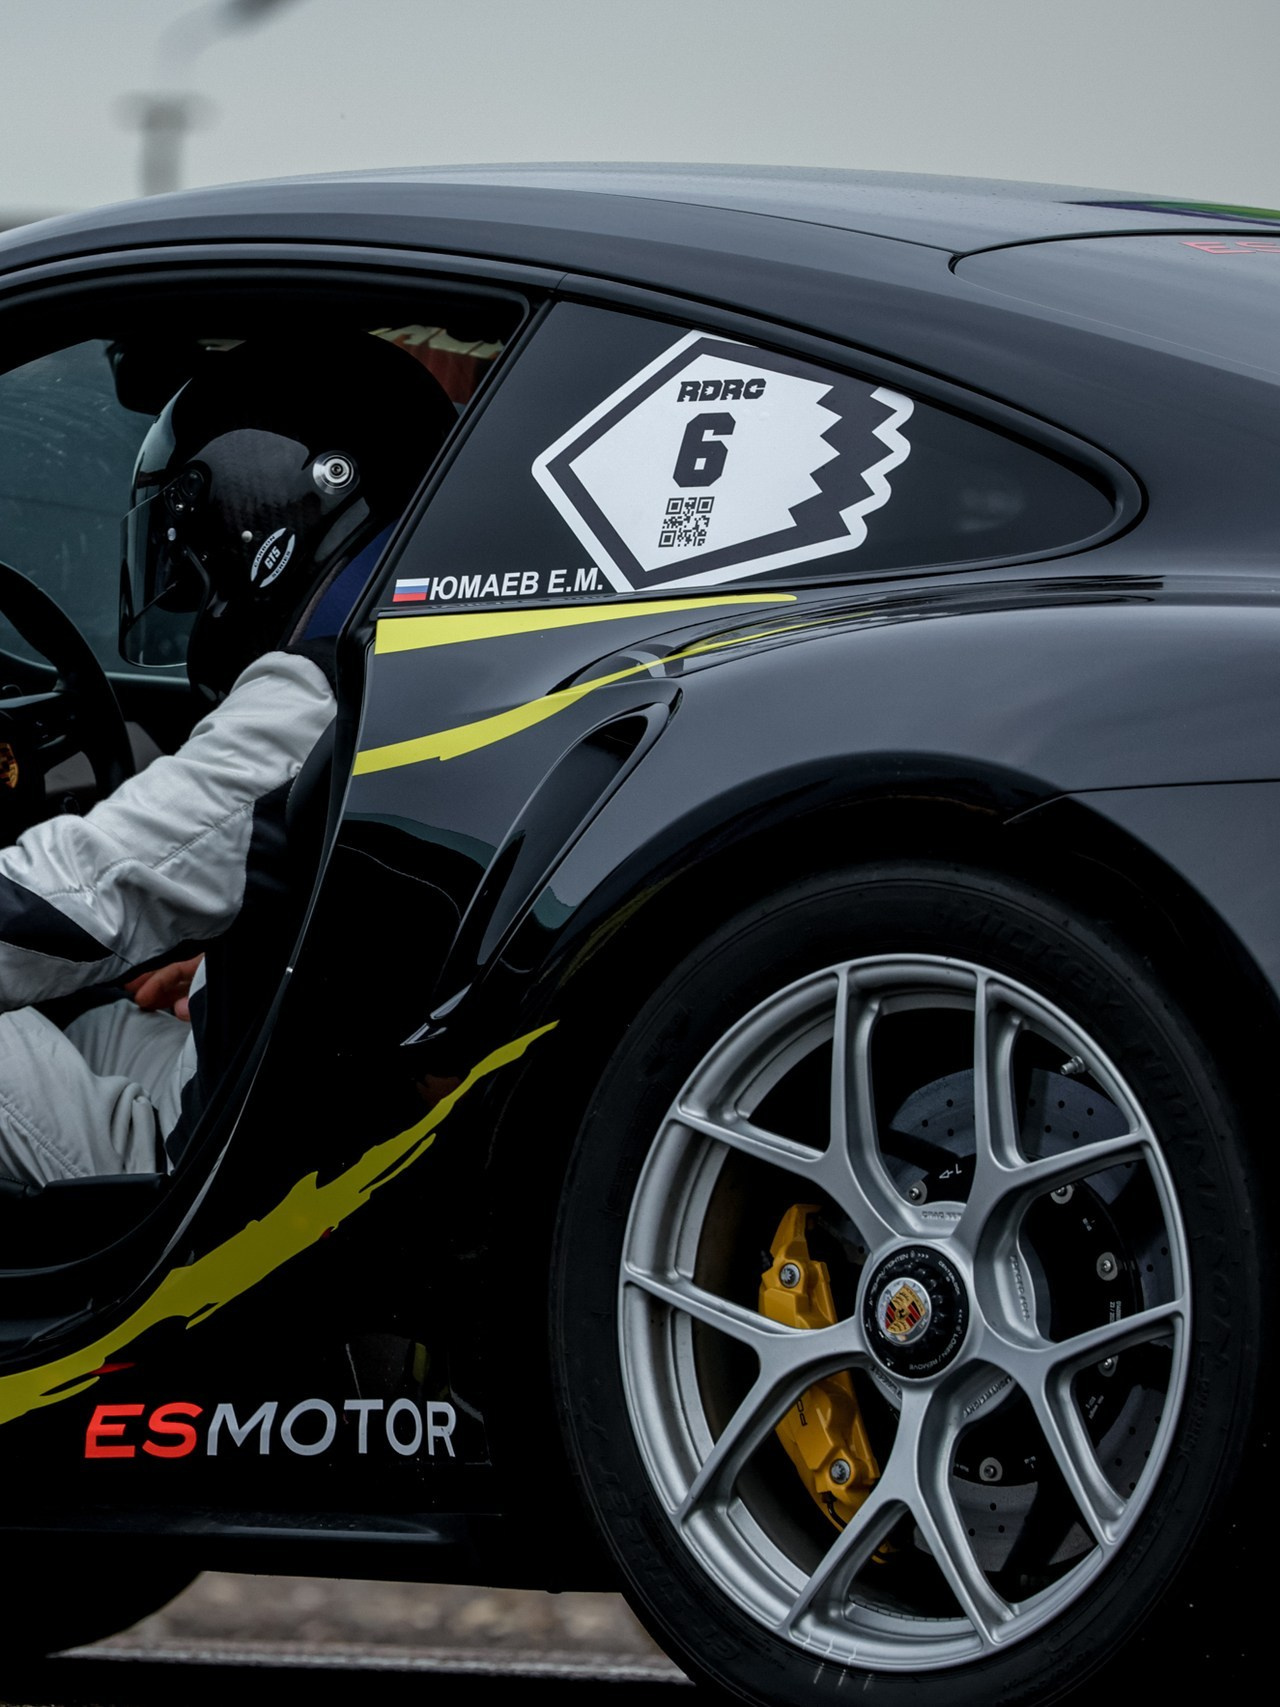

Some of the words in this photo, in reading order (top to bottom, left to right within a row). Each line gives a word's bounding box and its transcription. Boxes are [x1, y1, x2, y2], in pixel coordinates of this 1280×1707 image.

[677, 378, 766, 402] RDRC
[672, 412, 737, 488] 6
[265, 546, 281, 569] GTS
[429, 571, 539, 602] ЮМАЕВ
[548, 568, 603, 595] Е.М.
[84, 1397, 457, 1460] ESMOTOR
